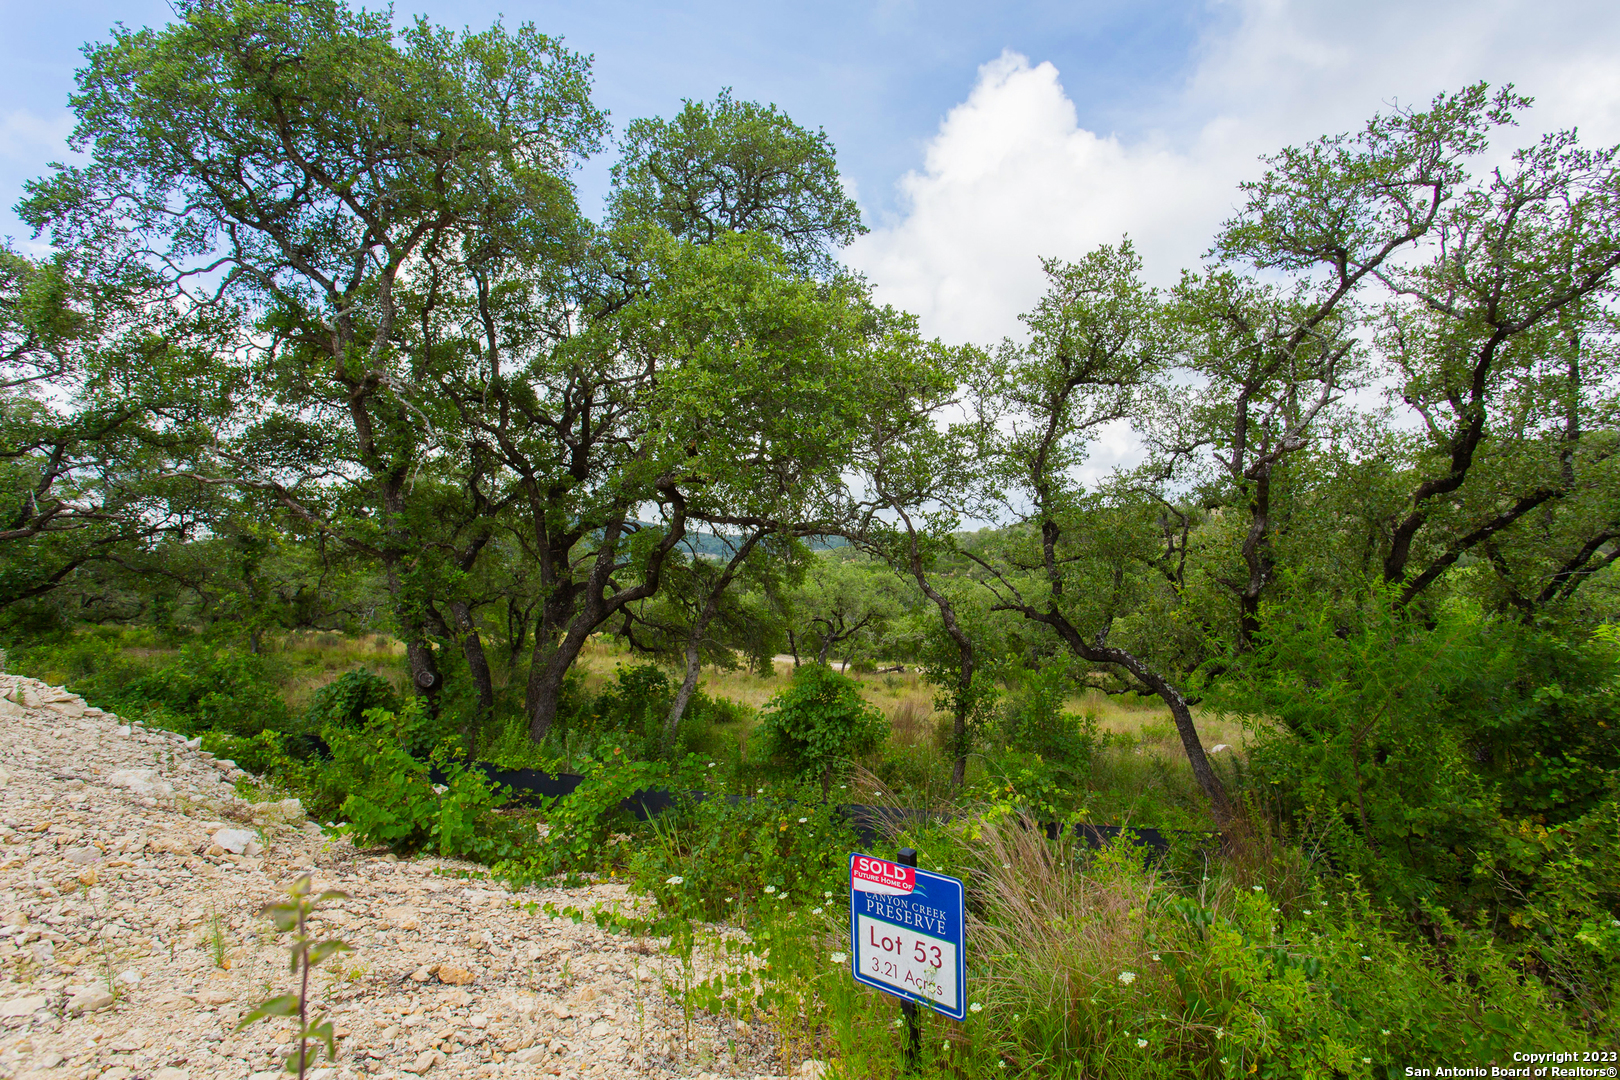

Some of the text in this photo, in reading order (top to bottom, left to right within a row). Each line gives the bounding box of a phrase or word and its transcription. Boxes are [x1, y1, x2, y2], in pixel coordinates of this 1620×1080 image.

[853, 870, 913, 890] FUTURE HOME OF
[859, 858, 907, 880] SOLD
[865, 892, 947, 921] CANYON CREEK
[866, 899, 946, 935] PRESERVE
[870, 925, 942, 969] Lot 53
[871, 957, 898, 979] 3.21
